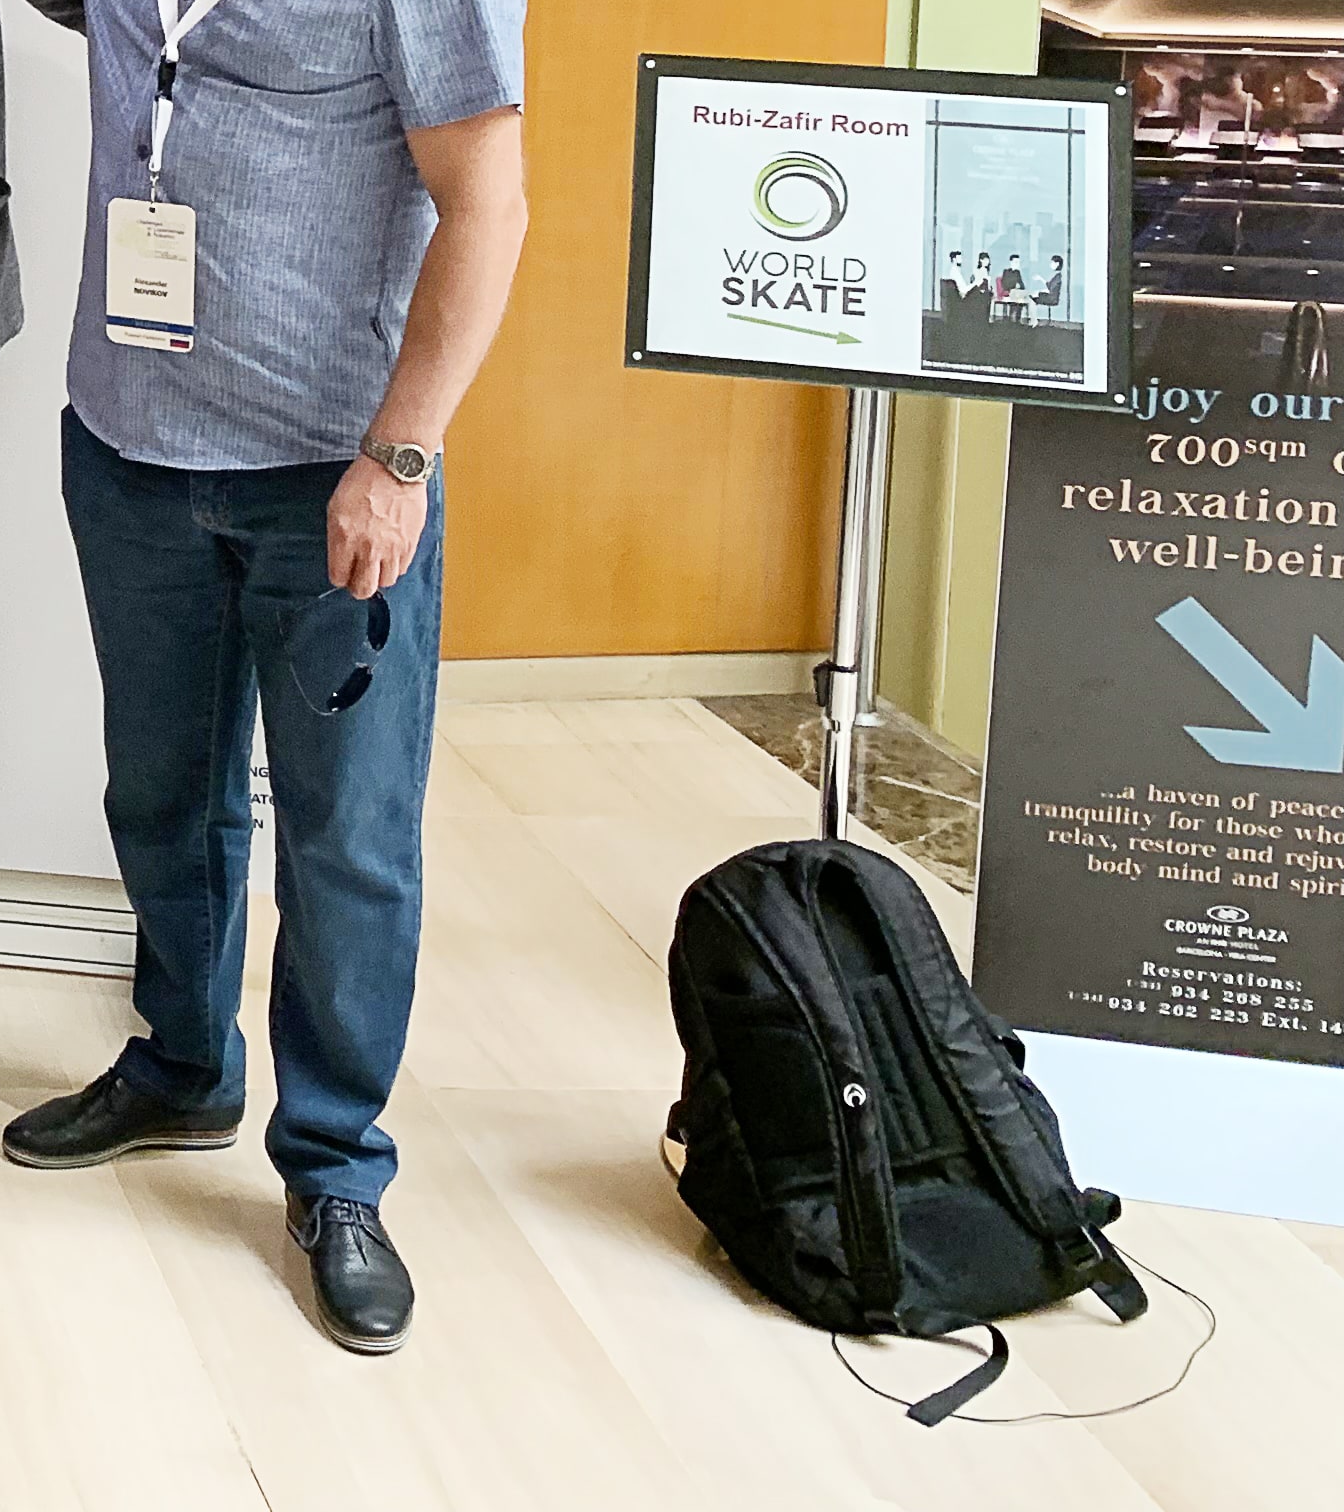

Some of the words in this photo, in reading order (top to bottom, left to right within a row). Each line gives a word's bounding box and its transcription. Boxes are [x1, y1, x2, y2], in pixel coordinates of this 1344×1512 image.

[693, 105, 823, 131] Rubi-Zafir
[831, 114, 910, 137] Room
[723, 248, 867, 283] WORLD
[721, 276, 867, 317] SKATE
[1061, 478, 1338, 527] relaxation
[1147, 783, 1220, 808] haven
[1232, 792, 1261, 811] of
[1270, 799, 1344, 819] peace
[1024, 800, 1157, 831] tranquility
[1169, 810, 1205, 831] for
[1216, 817, 1284, 839] those
[1295, 825, 1344, 845] who
[1047, 827, 1118, 852] relax,
[1129, 837, 1217, 858] restore
[1226, 845, 1273, 864] and
[1088, 853, 1148, 881] body
[1158, 861, 1220, 884] mind
[1232, 871, 1280, 890] and
[1164, 919, 1232, 937] CROWNE
[1237, 926, 1289, 943] PLAZA
[1142, 961, 1303, 992] Reservations:
[1261, 1011, 1308, 1031] Ext.
